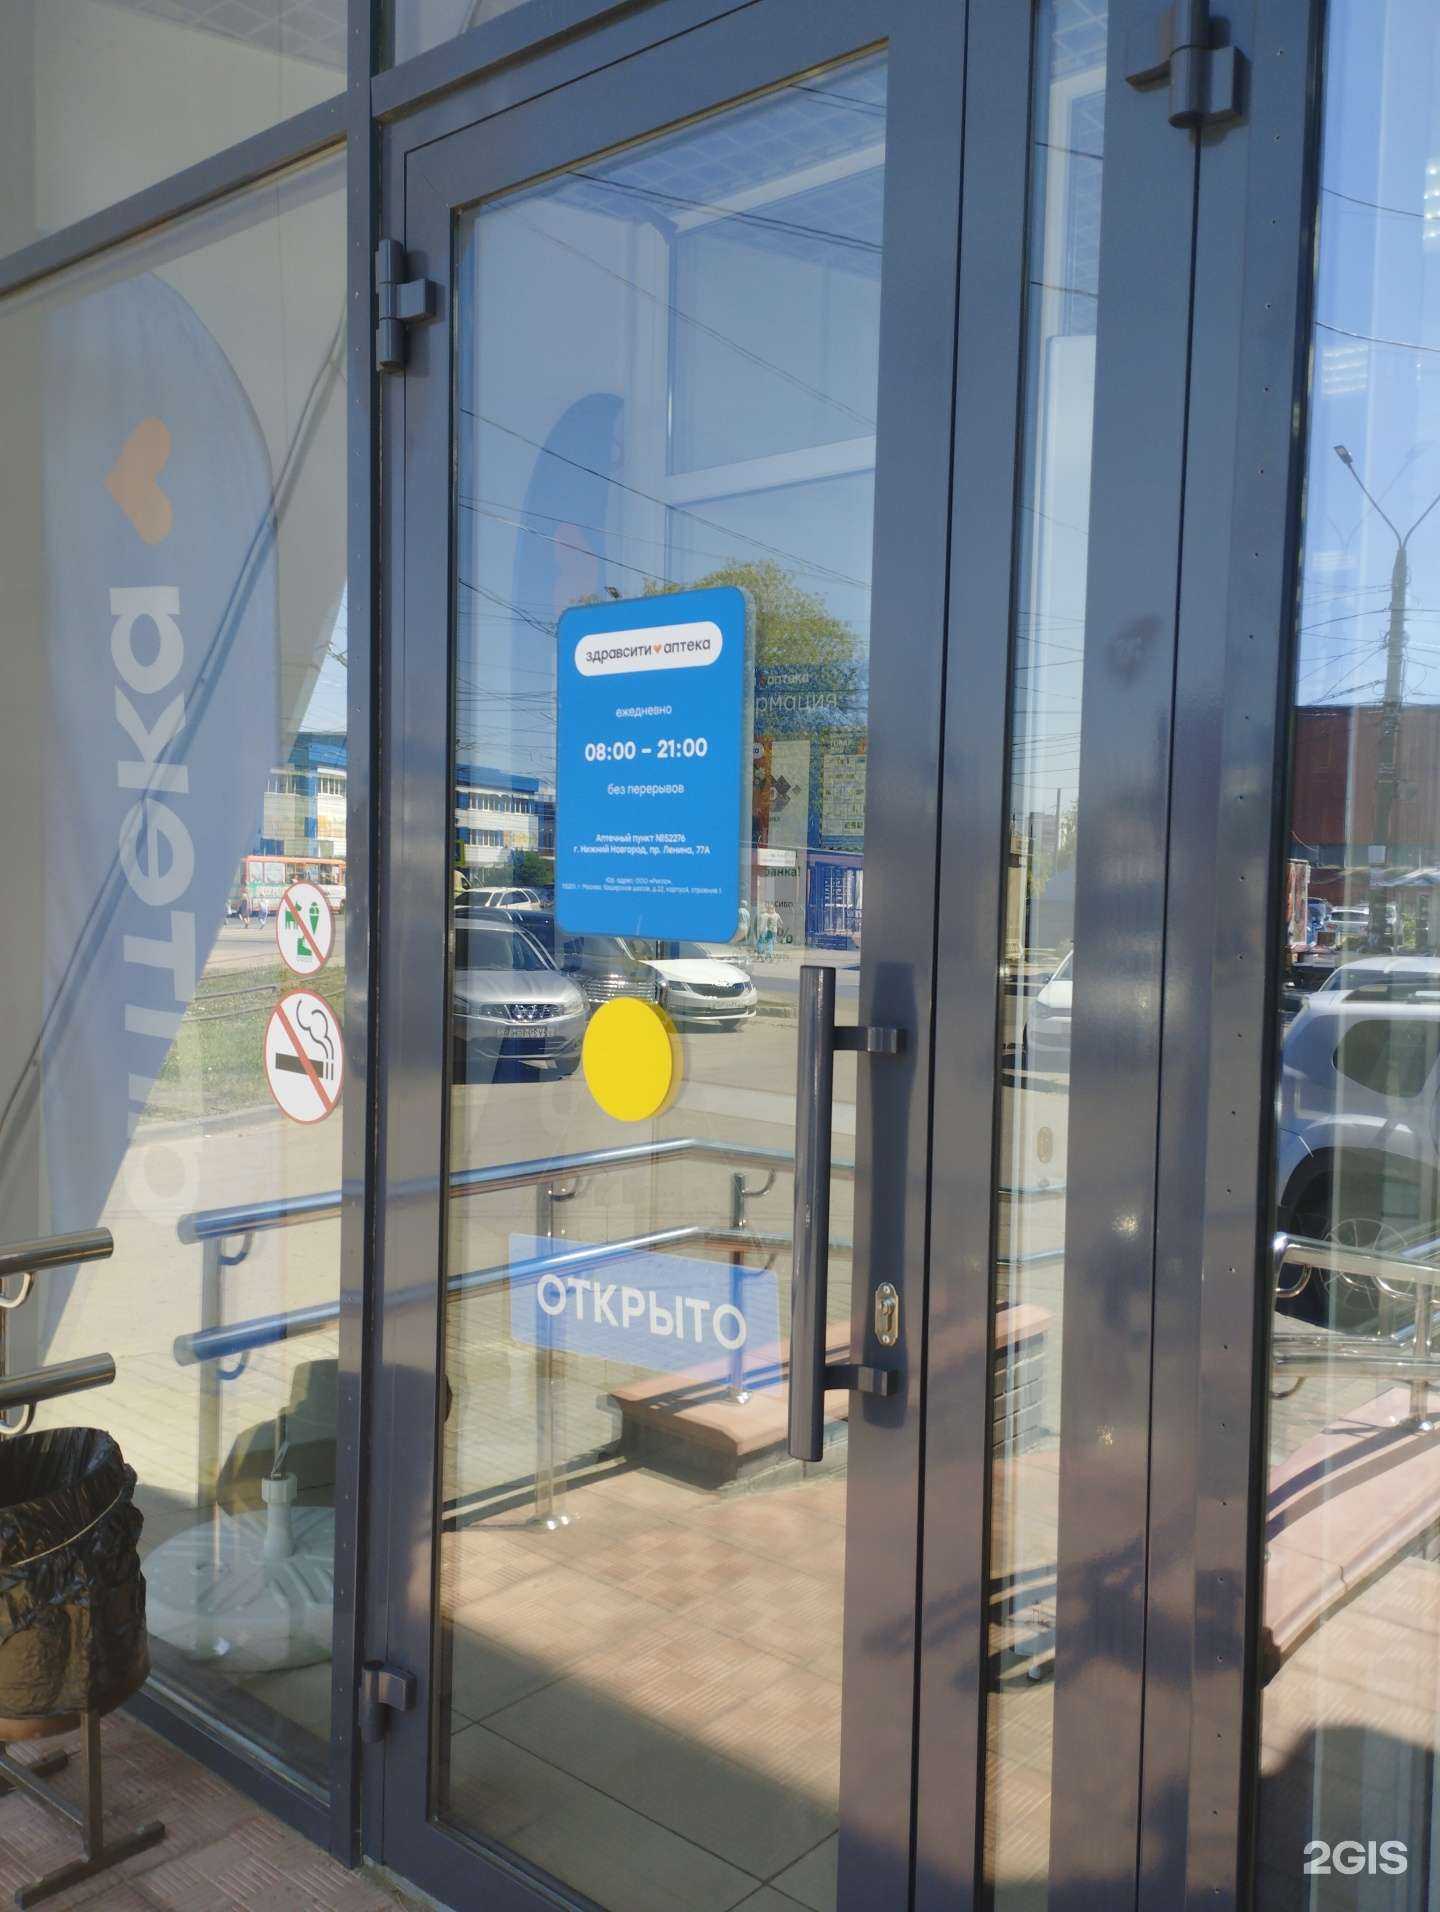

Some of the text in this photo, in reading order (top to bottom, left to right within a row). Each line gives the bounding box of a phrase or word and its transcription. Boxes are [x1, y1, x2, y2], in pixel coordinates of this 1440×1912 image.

[585, 638, 712, 664] здравсити аптека
[615, 704, 673, 719] ежедневно
[584, 741, 637, 762] 08:00
[656, 737, 709, 759] 21:00
[606, 783, 685, 797] без перерывов
[537, 1273, 748, 1350] ОТКРЫТО
